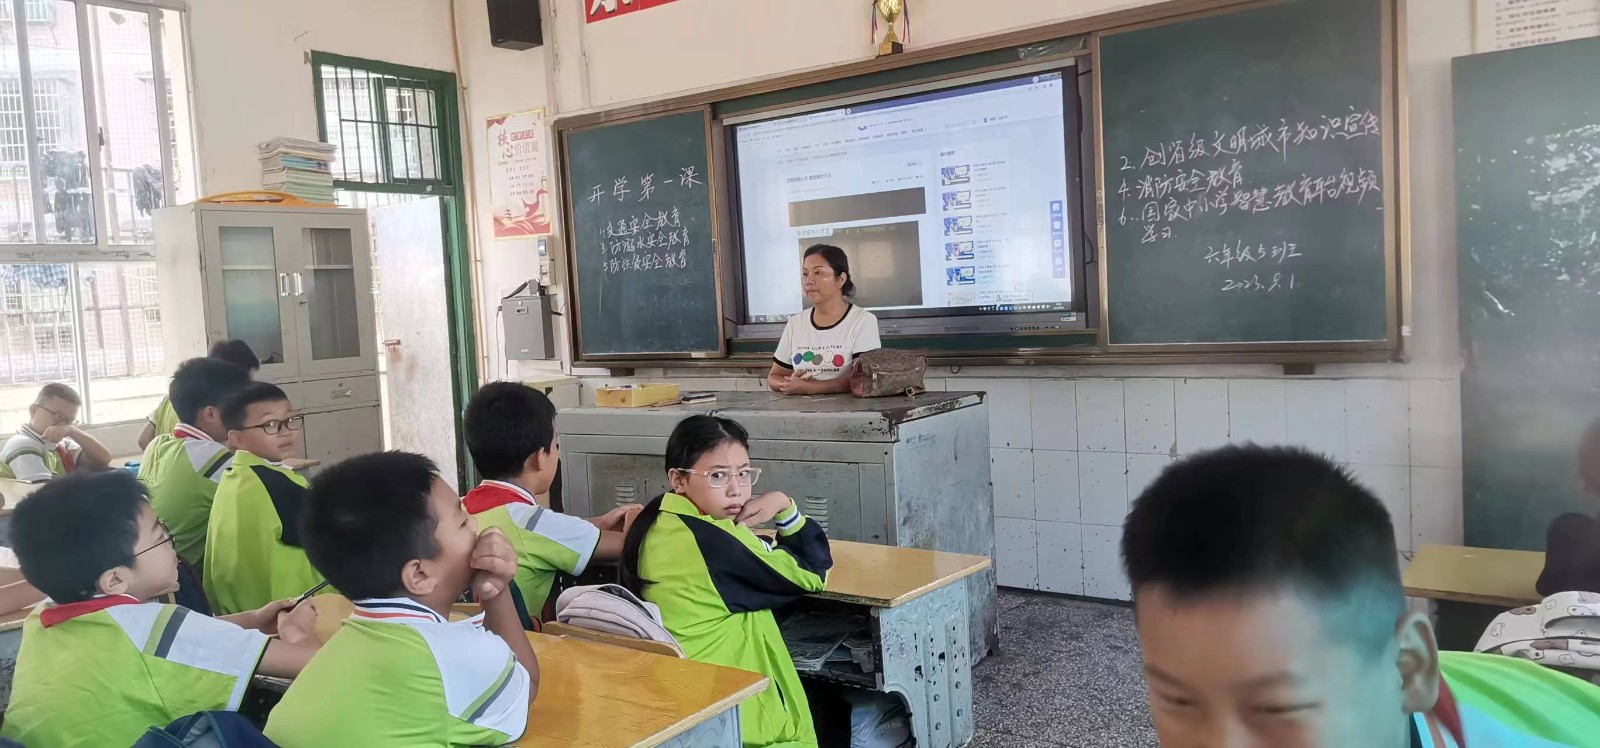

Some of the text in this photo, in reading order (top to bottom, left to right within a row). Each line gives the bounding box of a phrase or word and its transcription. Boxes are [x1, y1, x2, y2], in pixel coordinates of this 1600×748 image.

[586, 165, 703, 205] 开学第一课
[1203, 239, 1303, 270] 六年级5班
